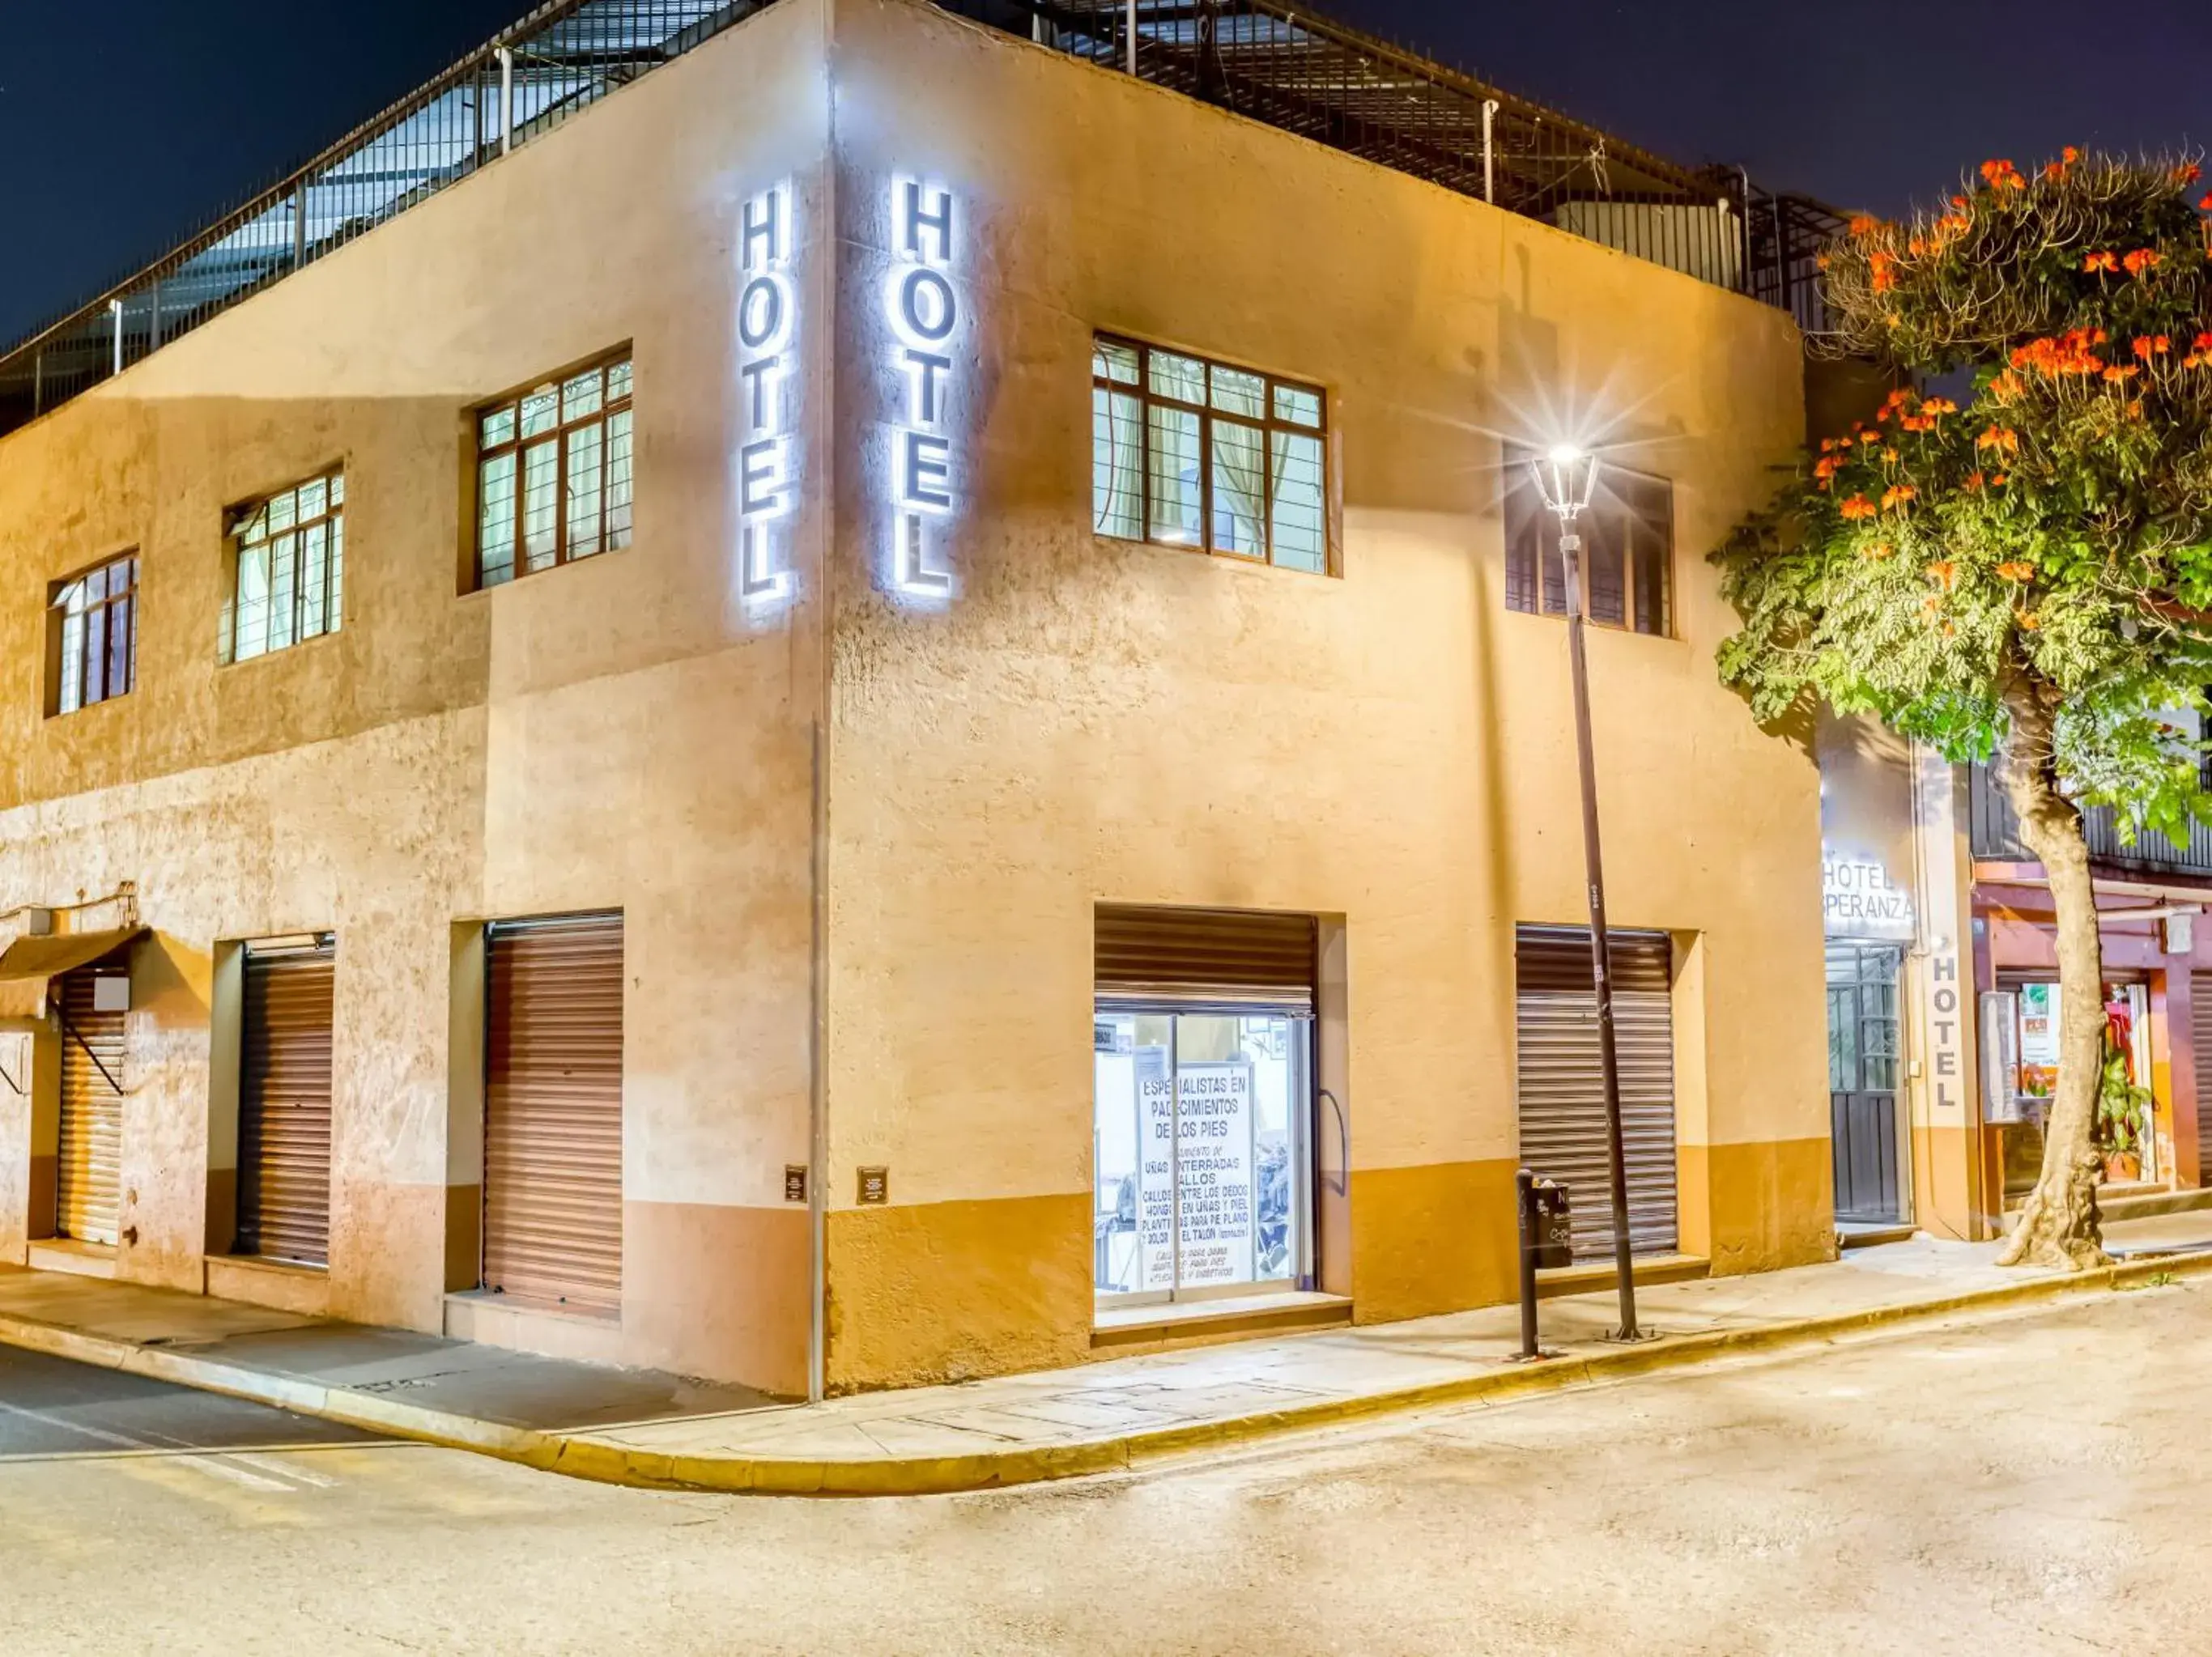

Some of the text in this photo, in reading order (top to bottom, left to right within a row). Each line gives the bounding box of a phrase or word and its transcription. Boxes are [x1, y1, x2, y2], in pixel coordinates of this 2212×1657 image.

[739, 189, 780, 597] HOTEL
[901, 181, 955, 588] HOTEL
[1823, 862, 1895, 890] HOTEL
[1933, 958, 1956, 1107] HOTEL
[1143, 1077, 1245, 1096] ESPEIALISTAS EN
[1155, 1123, 1170, 1139] DE
[1200, 1120, 1227, 1137] PIES
